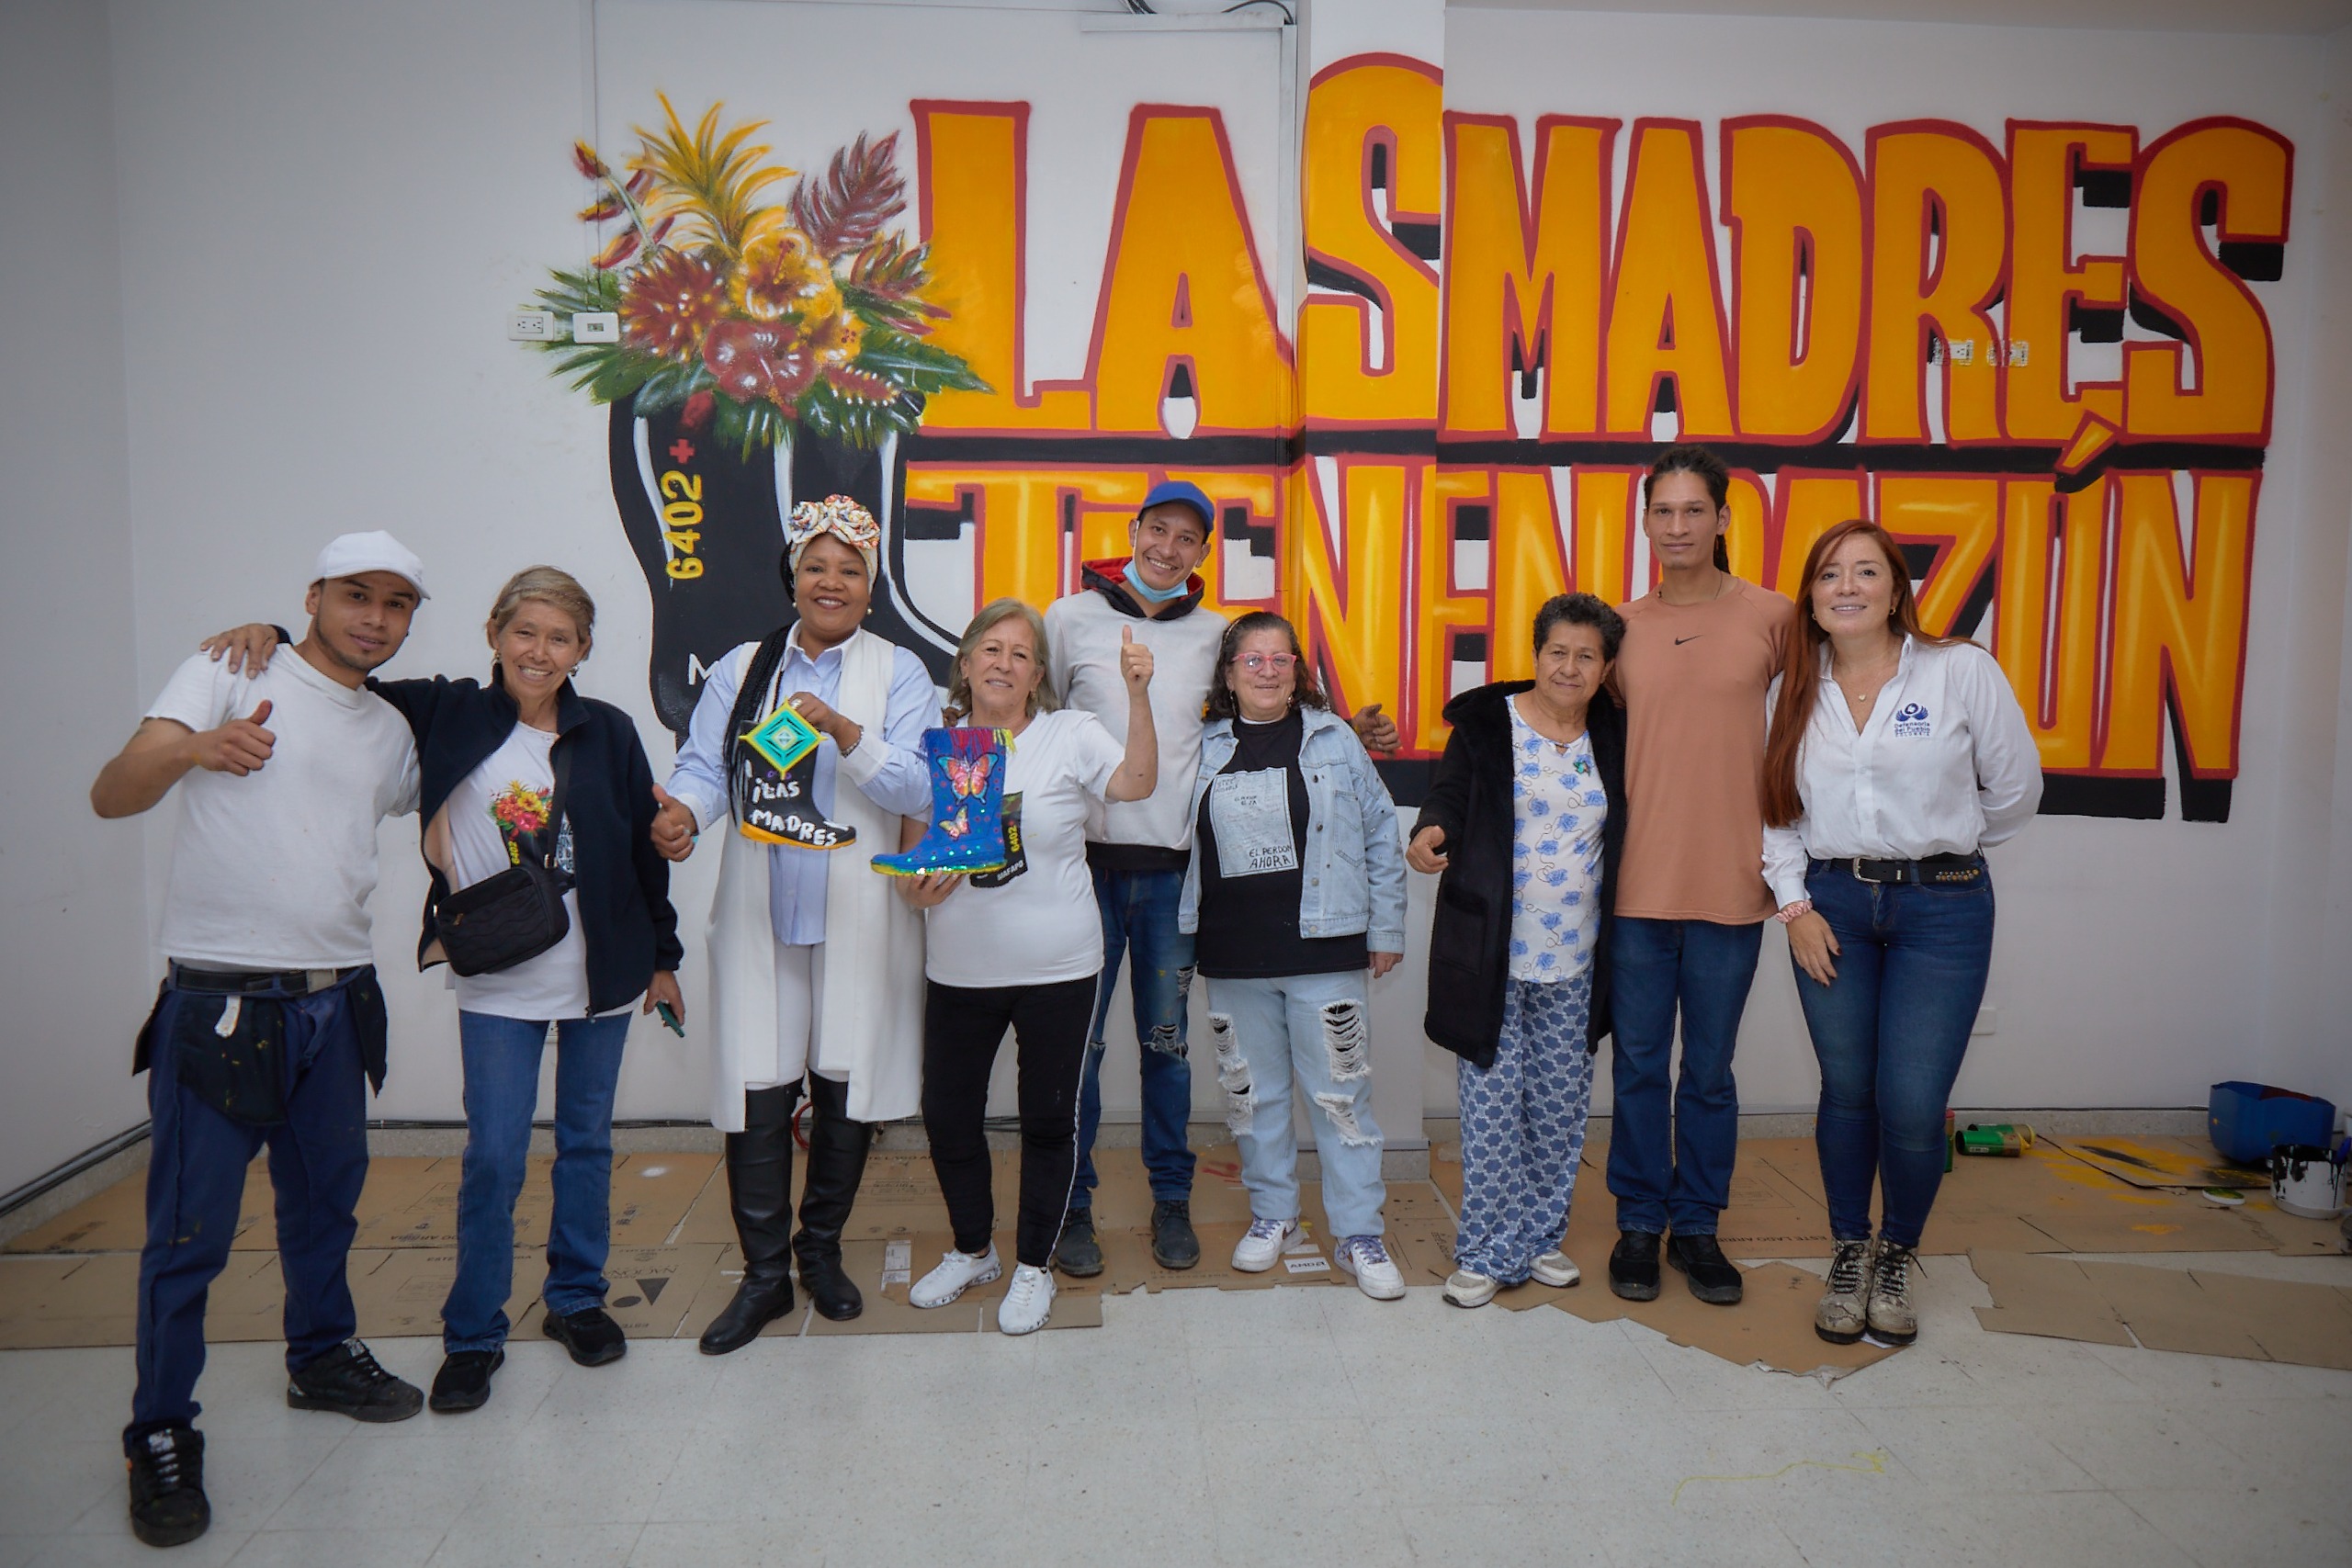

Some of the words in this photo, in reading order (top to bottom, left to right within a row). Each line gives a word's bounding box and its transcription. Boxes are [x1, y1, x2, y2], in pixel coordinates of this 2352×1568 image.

[909, 51, 1443, 436] LAS
[1438, 113, 2295, 449] MADRES
[749, 808, 838, 848] MADRES
[1249, 854, 1292, 869] AHORA
